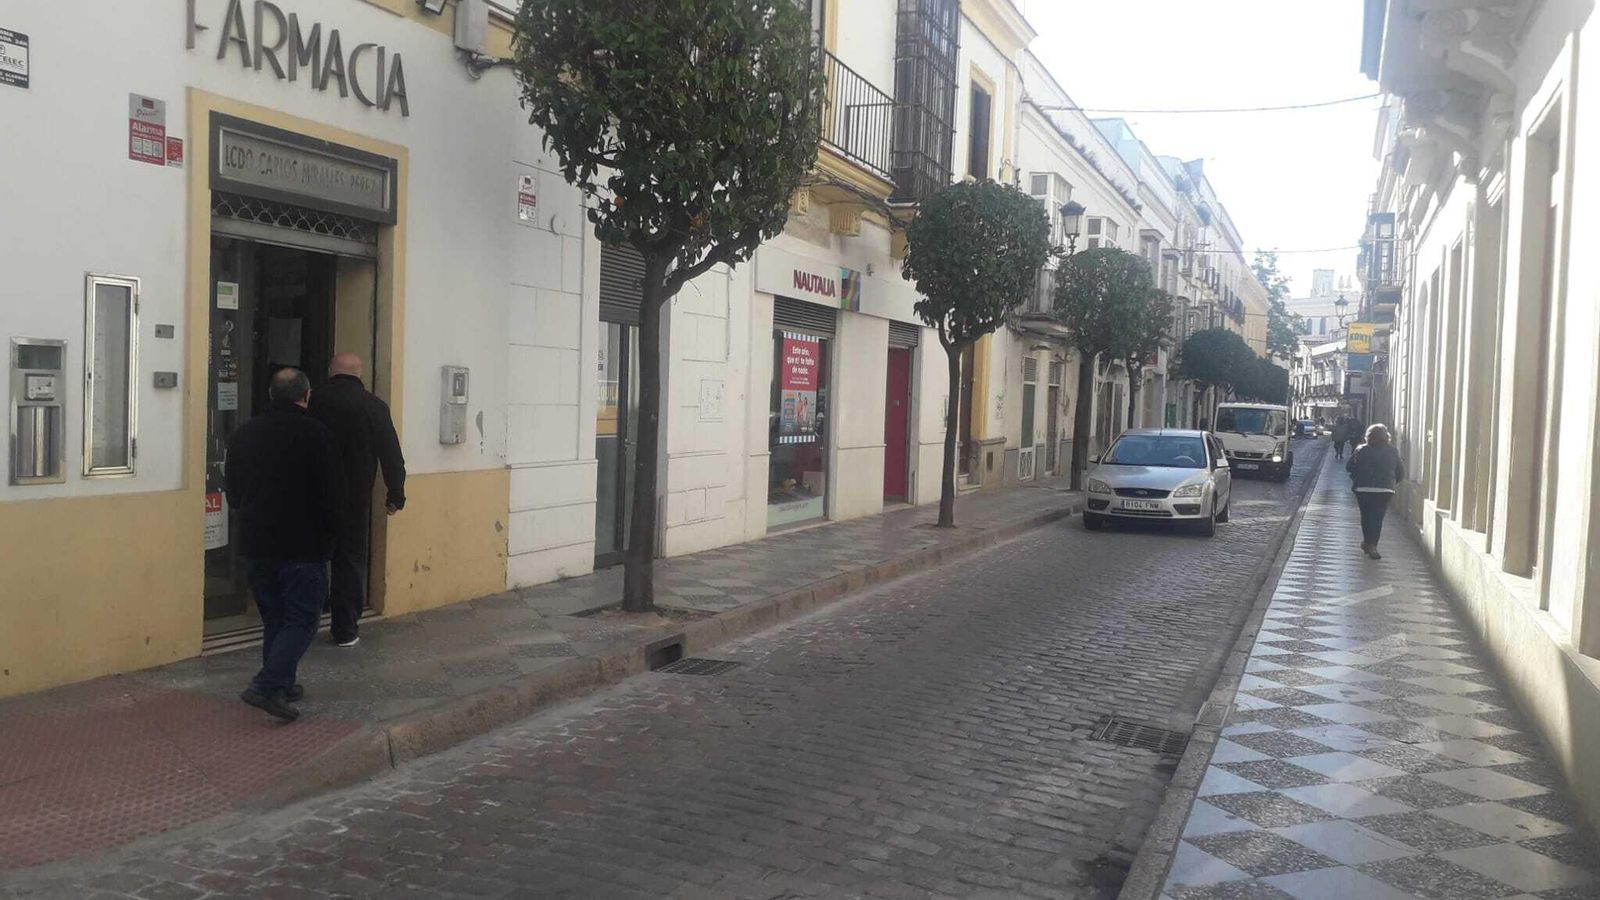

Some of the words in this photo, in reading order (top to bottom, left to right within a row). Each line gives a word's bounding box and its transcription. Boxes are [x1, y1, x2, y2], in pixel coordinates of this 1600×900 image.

[186, 0, 410, 117] FARMACIA
[132, 121, 164, 136] Alarma
[793, 268, 836, 298] NAUTALIA
